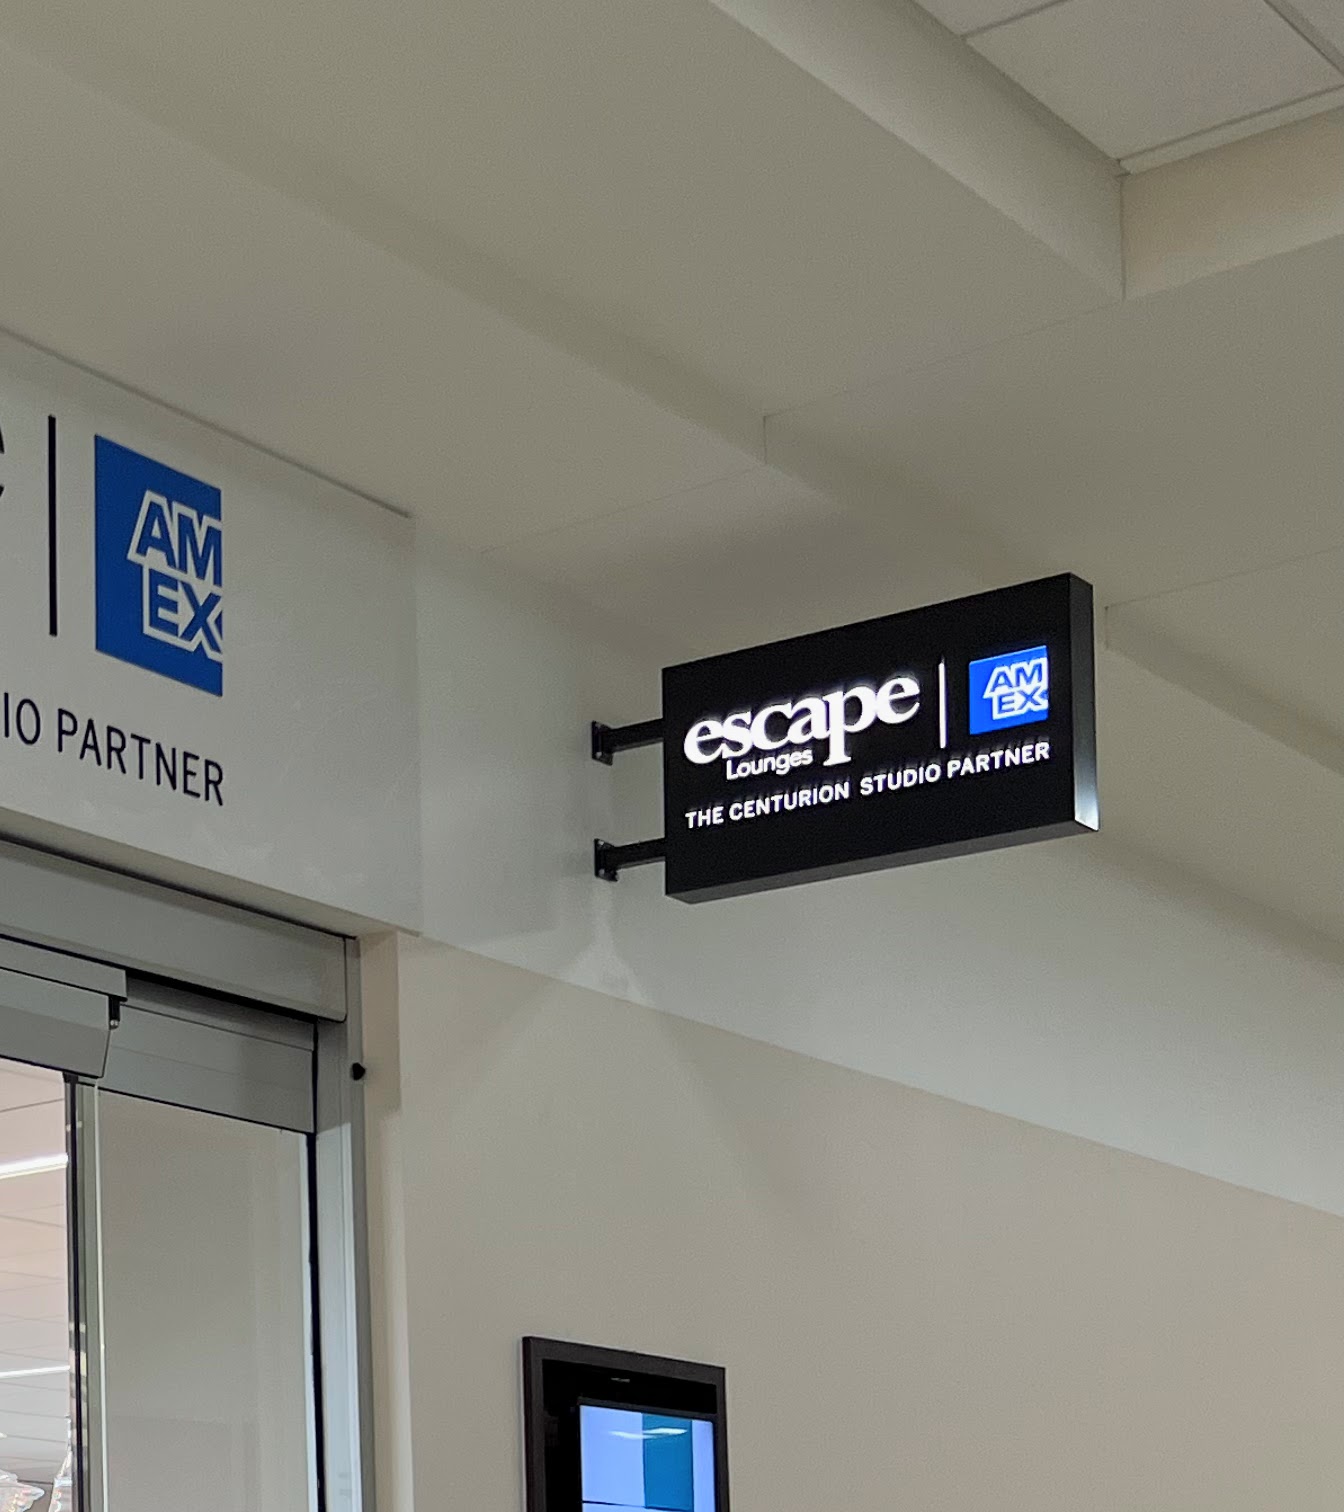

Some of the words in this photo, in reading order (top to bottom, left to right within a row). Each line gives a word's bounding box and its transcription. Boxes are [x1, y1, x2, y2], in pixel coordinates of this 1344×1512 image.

[57, 708, 224, 807] PARTNER
[683, 676, 921, 767] escape
[725, 748, 814, 781] Lounges
[684, 806, 725, 830] THE
[728, 781, 851, 822] CENTURION
[859, 763, 943, 797] STUDIO
[946, 741, 1051, 780] PARTNER
